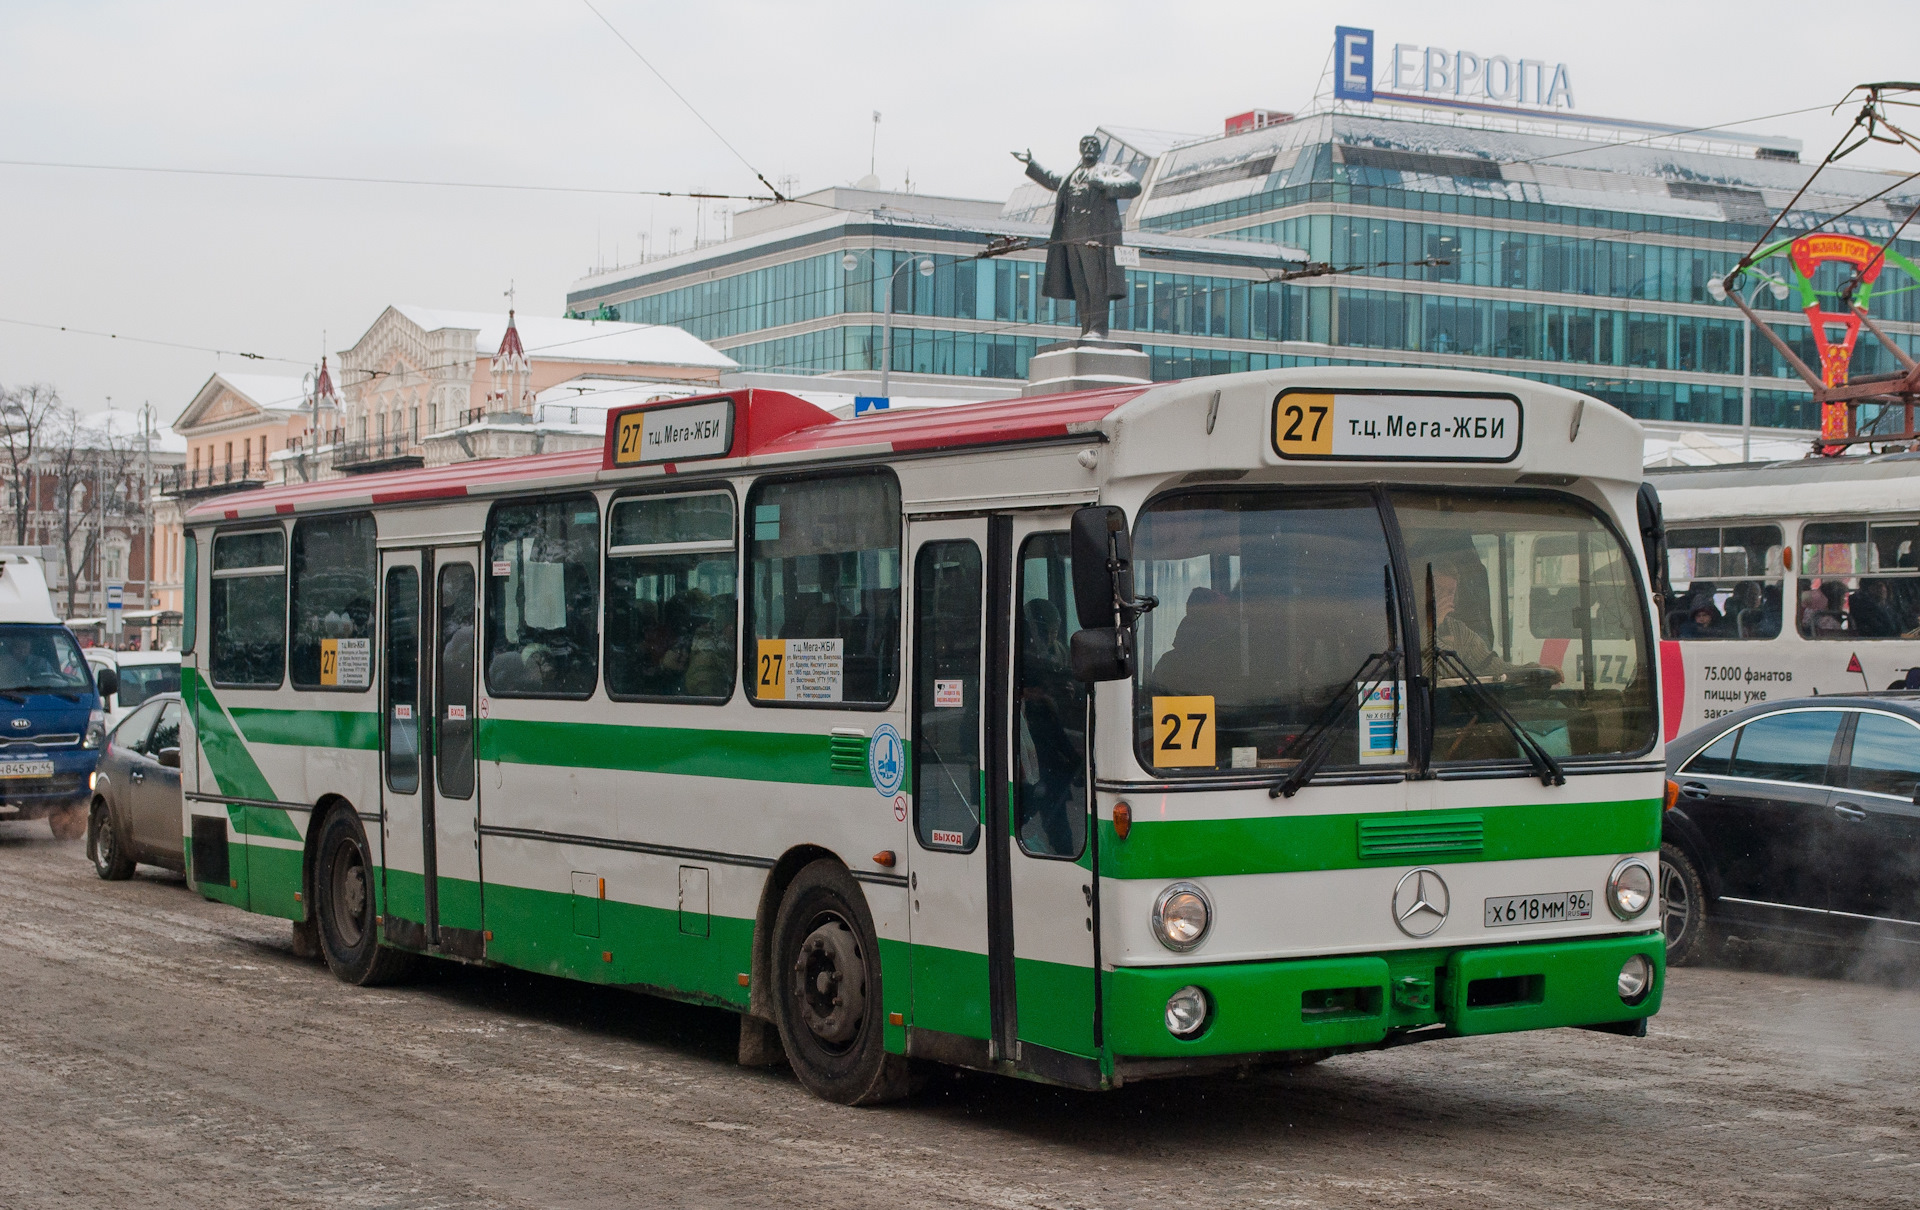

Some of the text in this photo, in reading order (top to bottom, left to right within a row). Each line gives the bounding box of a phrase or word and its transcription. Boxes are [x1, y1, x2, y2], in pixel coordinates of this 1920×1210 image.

[1343, 34, 1575, 109] Е ЕВРОПА
[1283, 405, 1505, 442] 27 т.ц. Мега-ЖБИ
[621, 419, 720, 453] 27 т.ц. Мега-ЖБИ
[803, 641, 836, 652] Мега-ЖБИ
[323, 650, 336, 674] 27
[761, 654, 783, 685] 27
[1704, 666, 1793, 684] 75.000 фанатов
[1704, 690, 1767, 704] пиццы уже
[398, 708, 410, 717] ВХОД
[450, 708, 464, 718] ВХОД
[1704, 709, 1733, 719] зака
[1161, 713, 1207, 750] 27
[933, 832, 962, 845] ВЫХОД
[1493, 894, 1586, 922] Х618ММ 96
